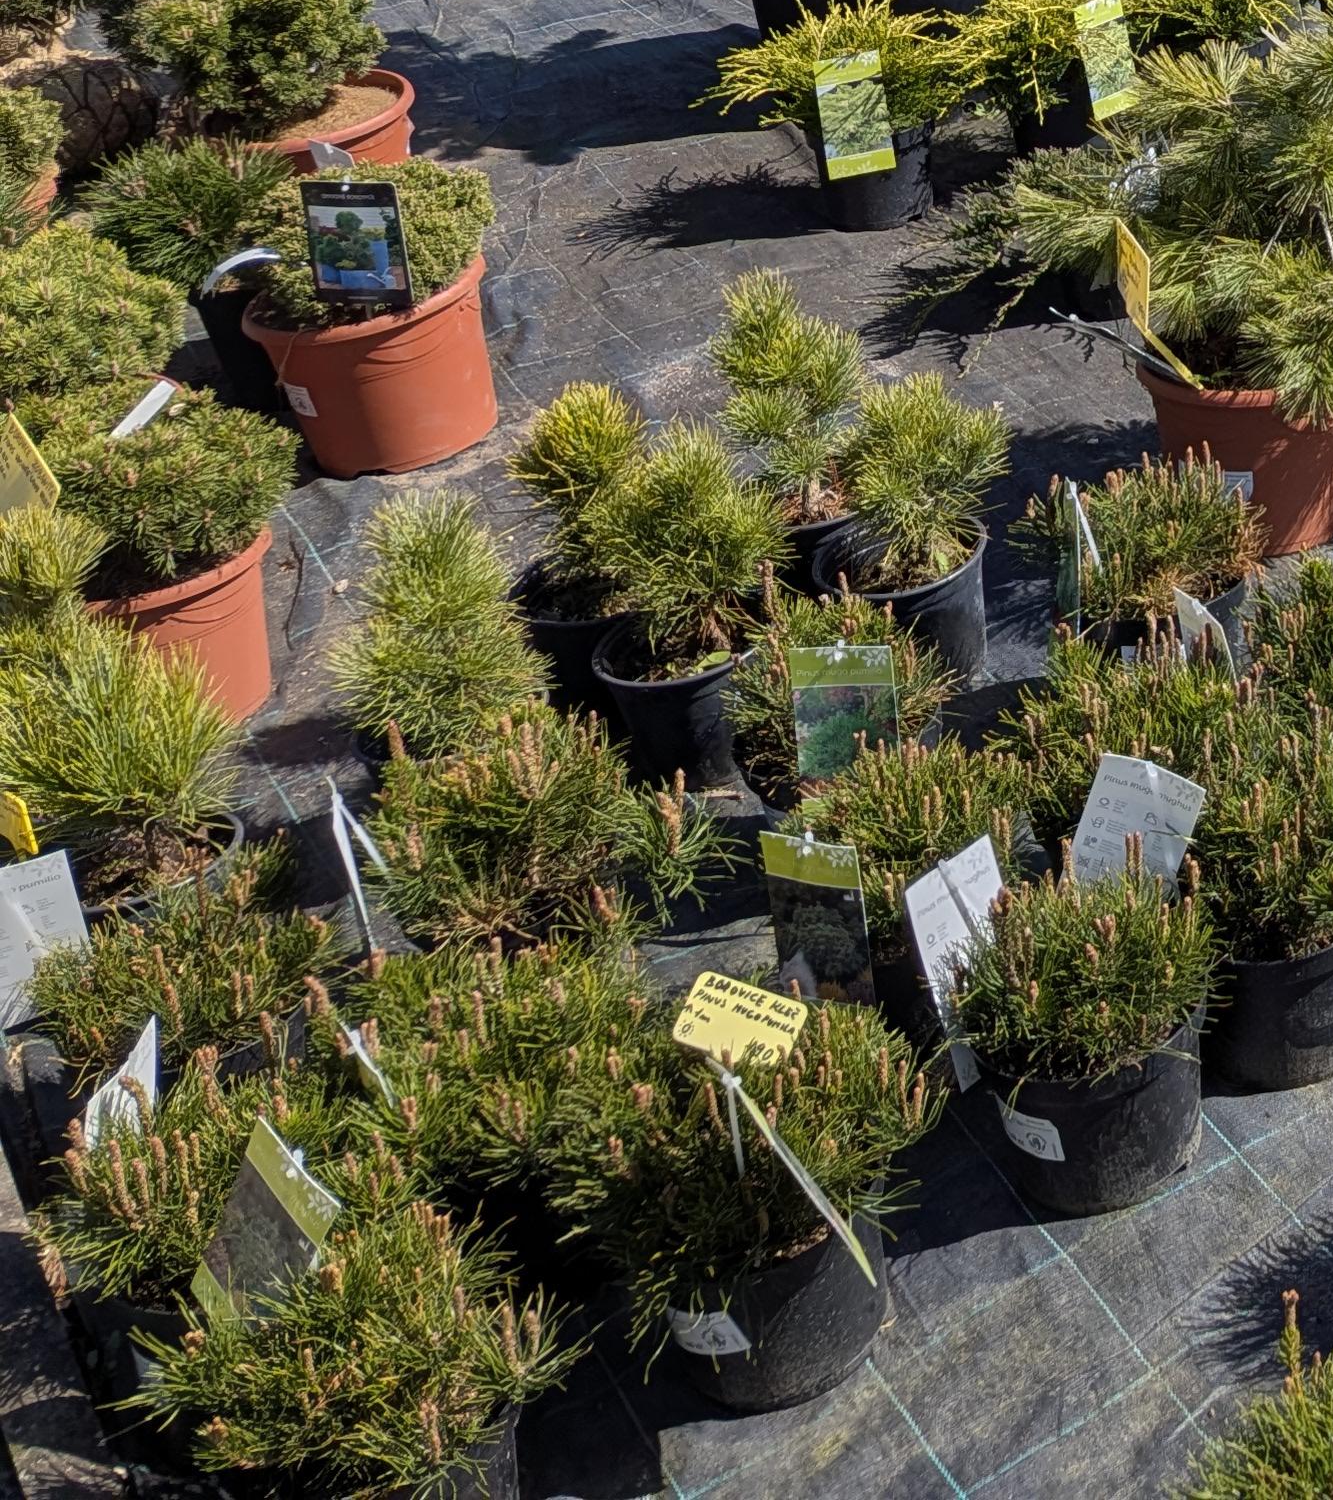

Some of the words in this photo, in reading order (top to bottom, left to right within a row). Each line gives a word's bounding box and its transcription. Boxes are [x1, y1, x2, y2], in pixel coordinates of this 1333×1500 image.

[1103, 773, 1129, 787] Pinus
[18, 873, 62, 893] pumilio
[693, 988, 727, 1009] PINUS
[704, 975, 767, 1007] BOROVICE
